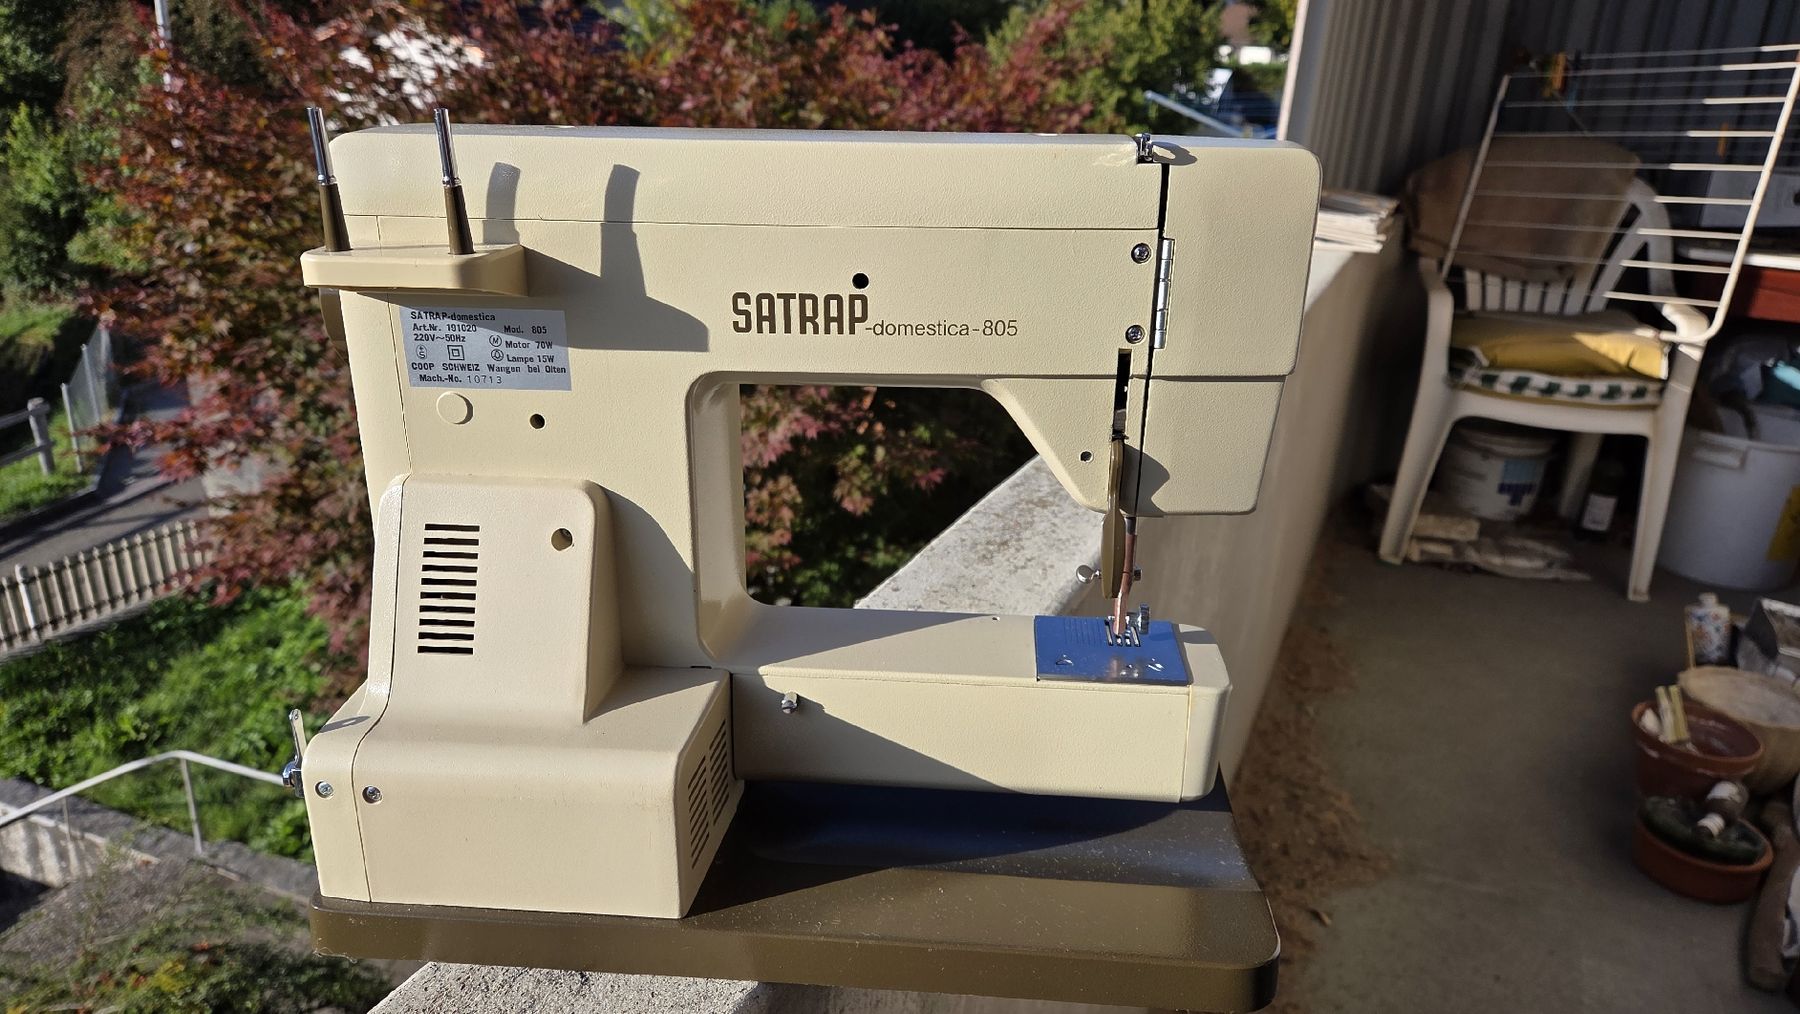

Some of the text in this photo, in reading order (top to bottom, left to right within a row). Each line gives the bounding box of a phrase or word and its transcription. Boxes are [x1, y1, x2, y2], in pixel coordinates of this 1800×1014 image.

[412, 323, 478, 332] Art.Nr. 191020
[503, 325, 547, 334] Mod. 805
[505, 340, 553, 350] Motor 70W
[506, 354, 555, 364] Lampe 15W
[411, 362, 435, 371] COOP
[442, 363, 480, 372] SCHWEIZ
[487, 364, 521, 374] Wangen
[545, 365, 567, 373] Olten
[467, 375, 503, 384] 10713
